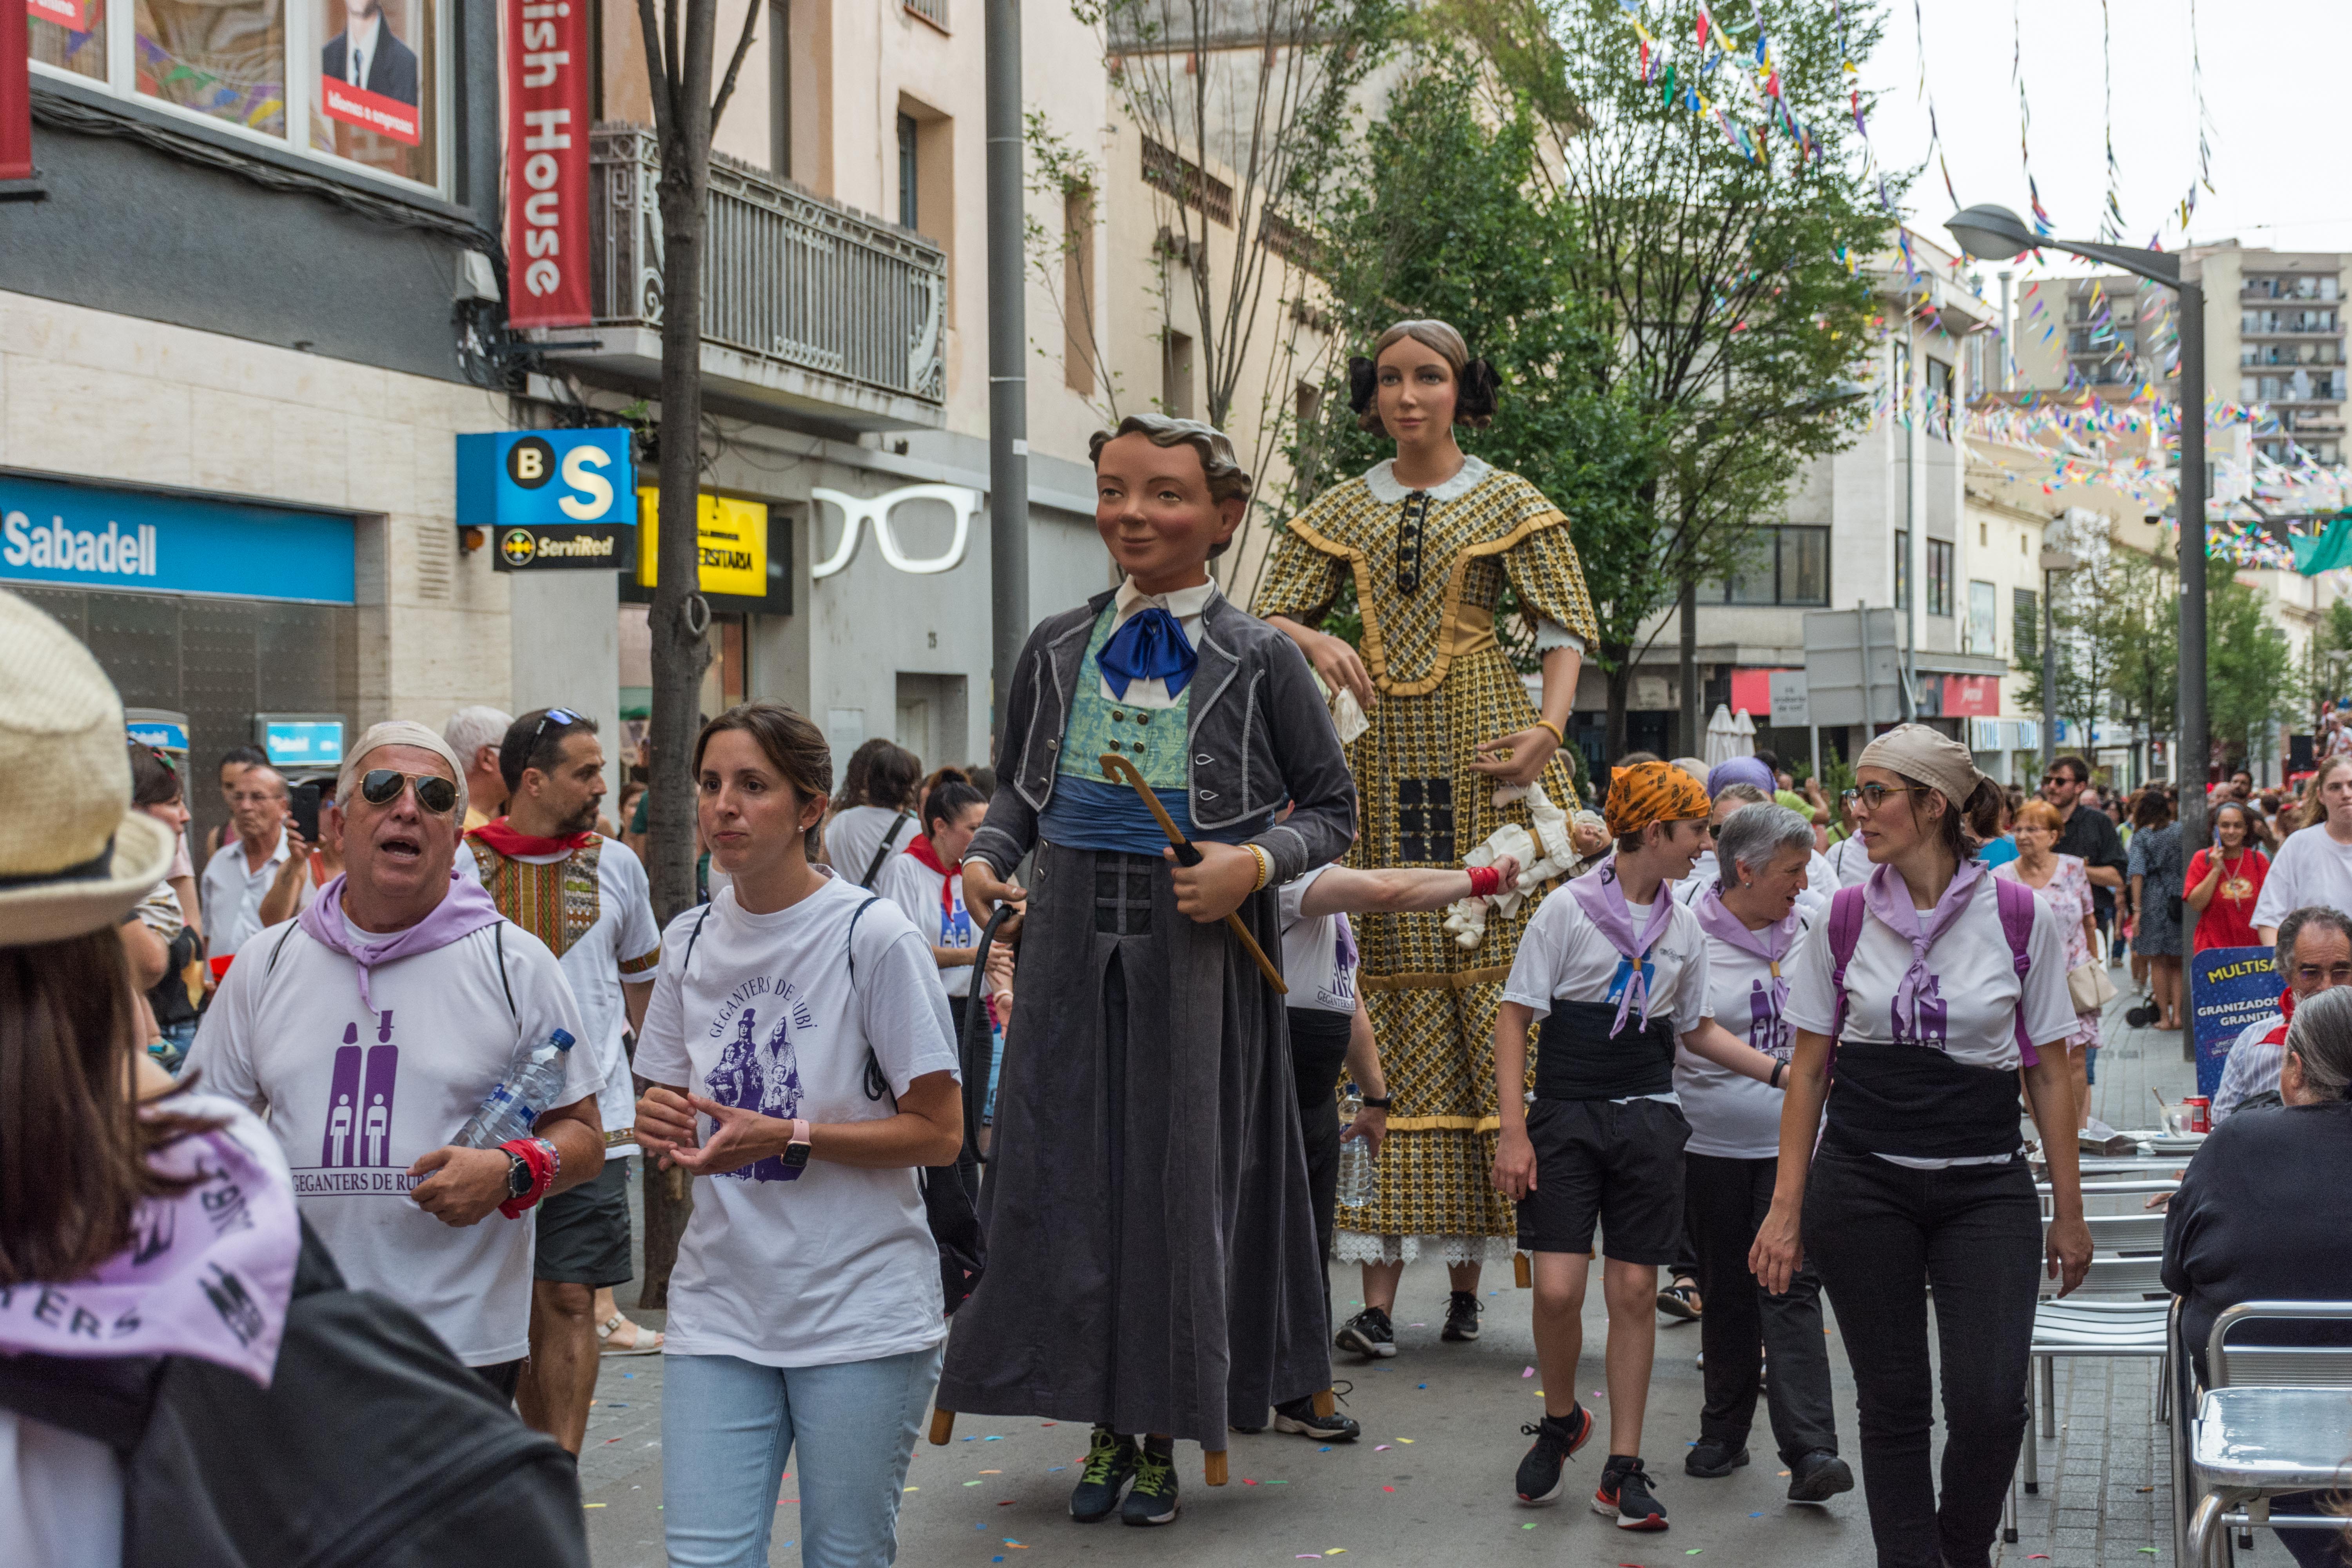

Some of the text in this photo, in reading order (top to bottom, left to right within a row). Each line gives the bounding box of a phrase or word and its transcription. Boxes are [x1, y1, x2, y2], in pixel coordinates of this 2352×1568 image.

[523, 0, 572, 298] ish House
[3, 510, 157, 576] Sabadell
[537, 535, 614, 557] ServiRed
[709, 976, 771, 1038] GEGANTERS
[774, 978, 795, 1001] DE
[1317, 991, 1350, 1009] GEGANTERS
[2197, 996, 2279, 1017] GRANIZADOS
[292, 1173, 424, 1192] GEGANTERS DE RUB
